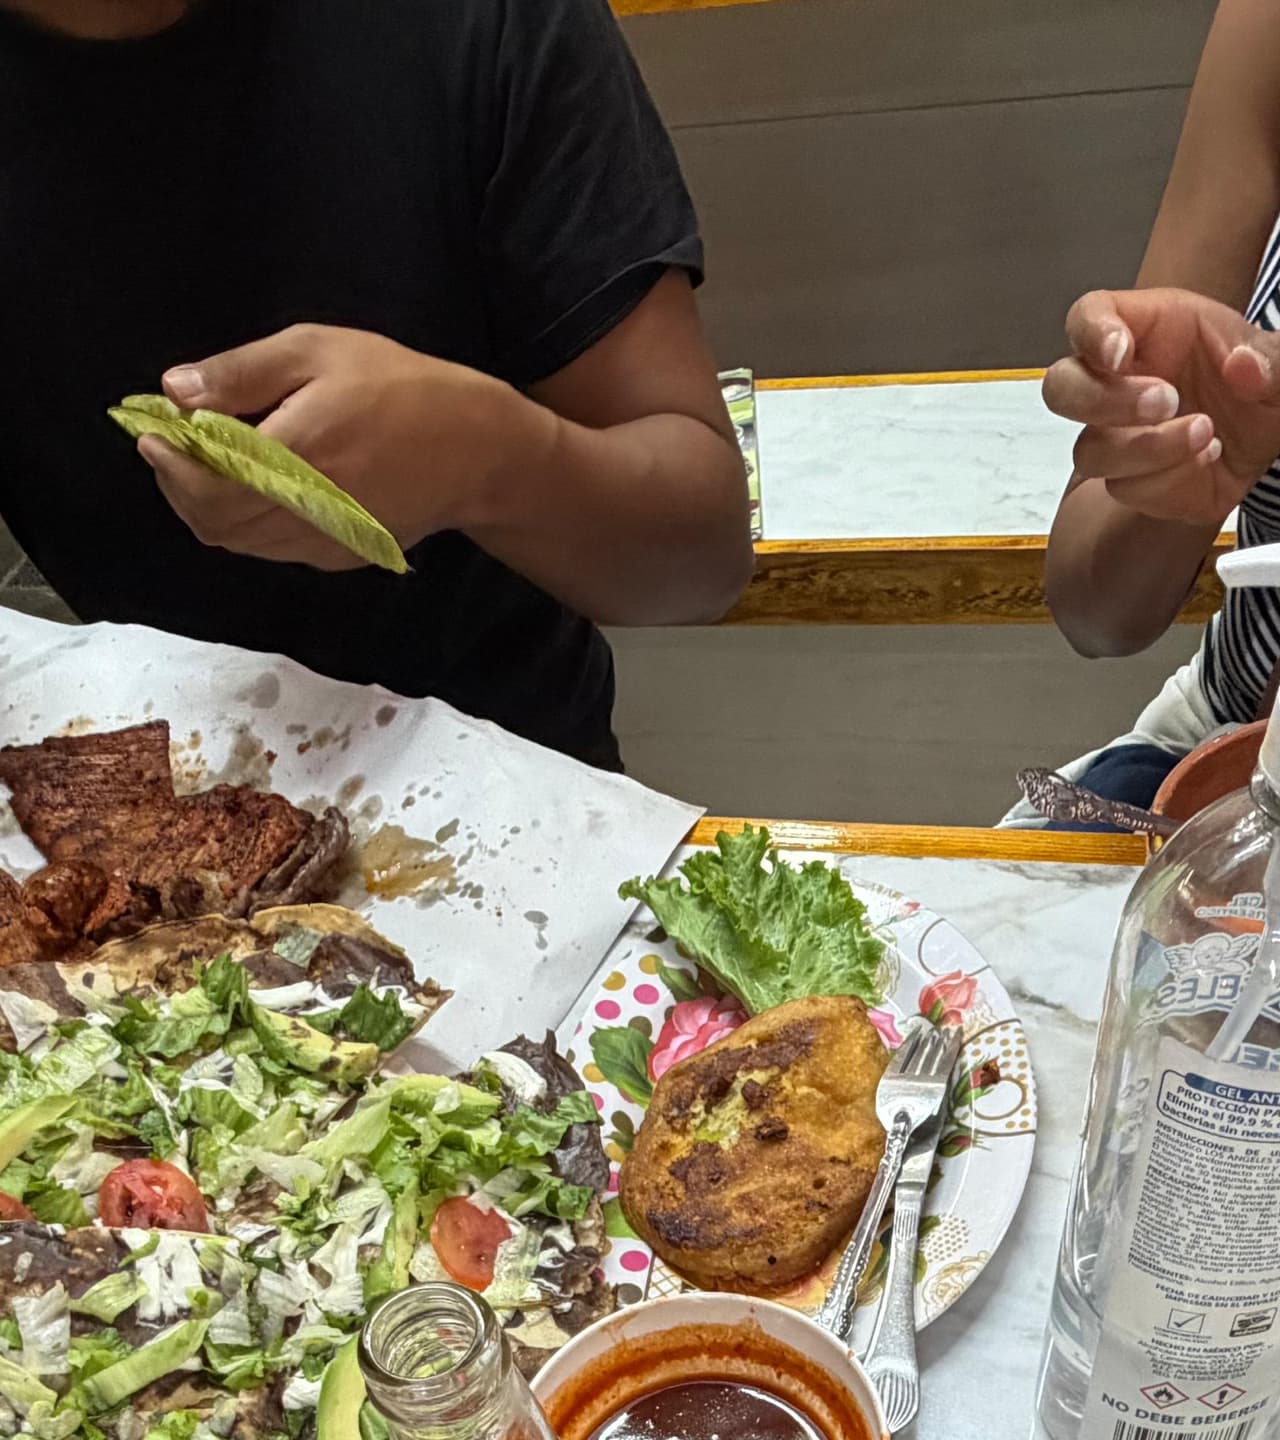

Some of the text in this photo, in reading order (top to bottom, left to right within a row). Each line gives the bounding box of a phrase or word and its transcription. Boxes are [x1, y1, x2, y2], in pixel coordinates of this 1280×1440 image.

[1165, 1091, 1210, 1116] Elimina
[1212, 1109, 1225, 1121] el
[1227, 1112, 1256, 1127] 99.9
[1260, 1119, 1274, 1129] %
[1176, 1085, 1260, 1117] PROTECCIÓN
[1215, 1085, 1245, 1101] GEL
[1161, 1101, 1216, 1130] bacterias
[1218, 1122, 1238, 1136] sin
[1101, 1392, 1270, 1426] NO DEBE BEBERSE
